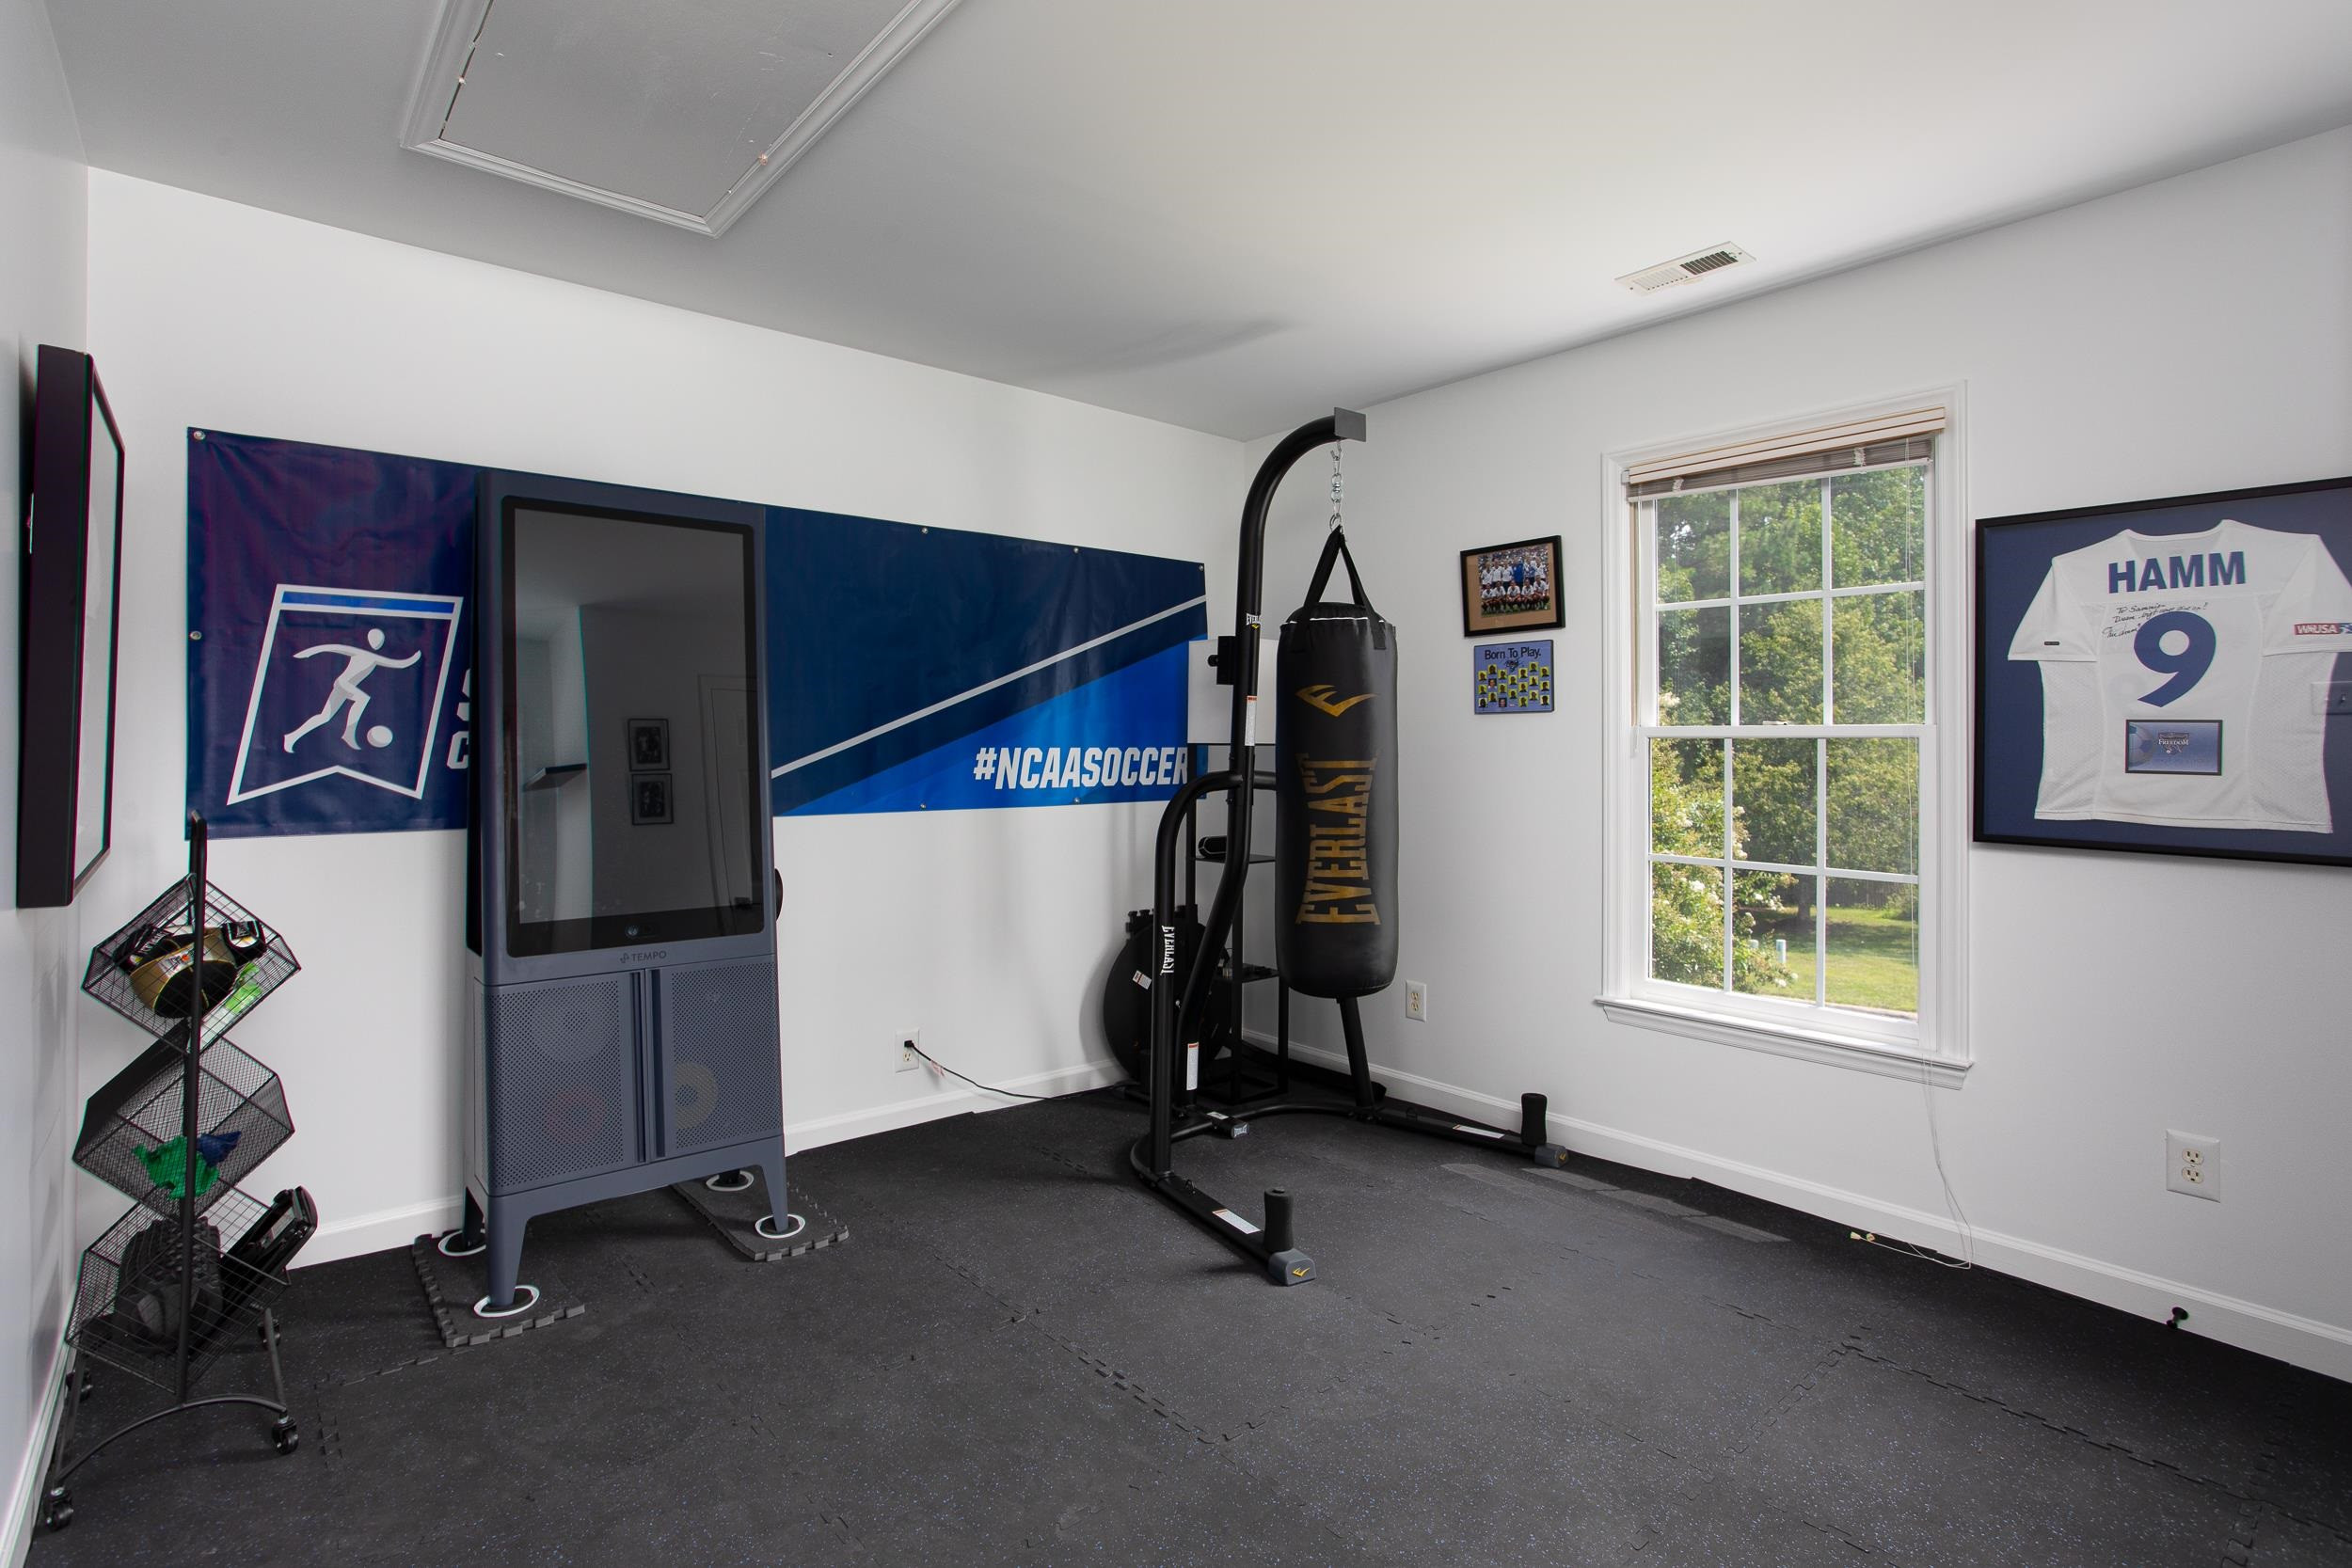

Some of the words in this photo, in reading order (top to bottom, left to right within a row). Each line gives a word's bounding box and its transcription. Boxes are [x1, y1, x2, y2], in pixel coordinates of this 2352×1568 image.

[2108, 551, 2246, 594] HAMM
[1485, 649, 1505, 660] Born
[1508, 647, 1518, 658] To
[1520, 646, 1542, 658] Play.
[2134, 611, 2216, 707] 9
[974, 747, 1188, 790] #NCAASOCCER
[1295, 752, 1381, 926] EVERLAST
[631, 950, 667, 961] TEMPO
[1159, 925, 1175, 975] EVERLAST
